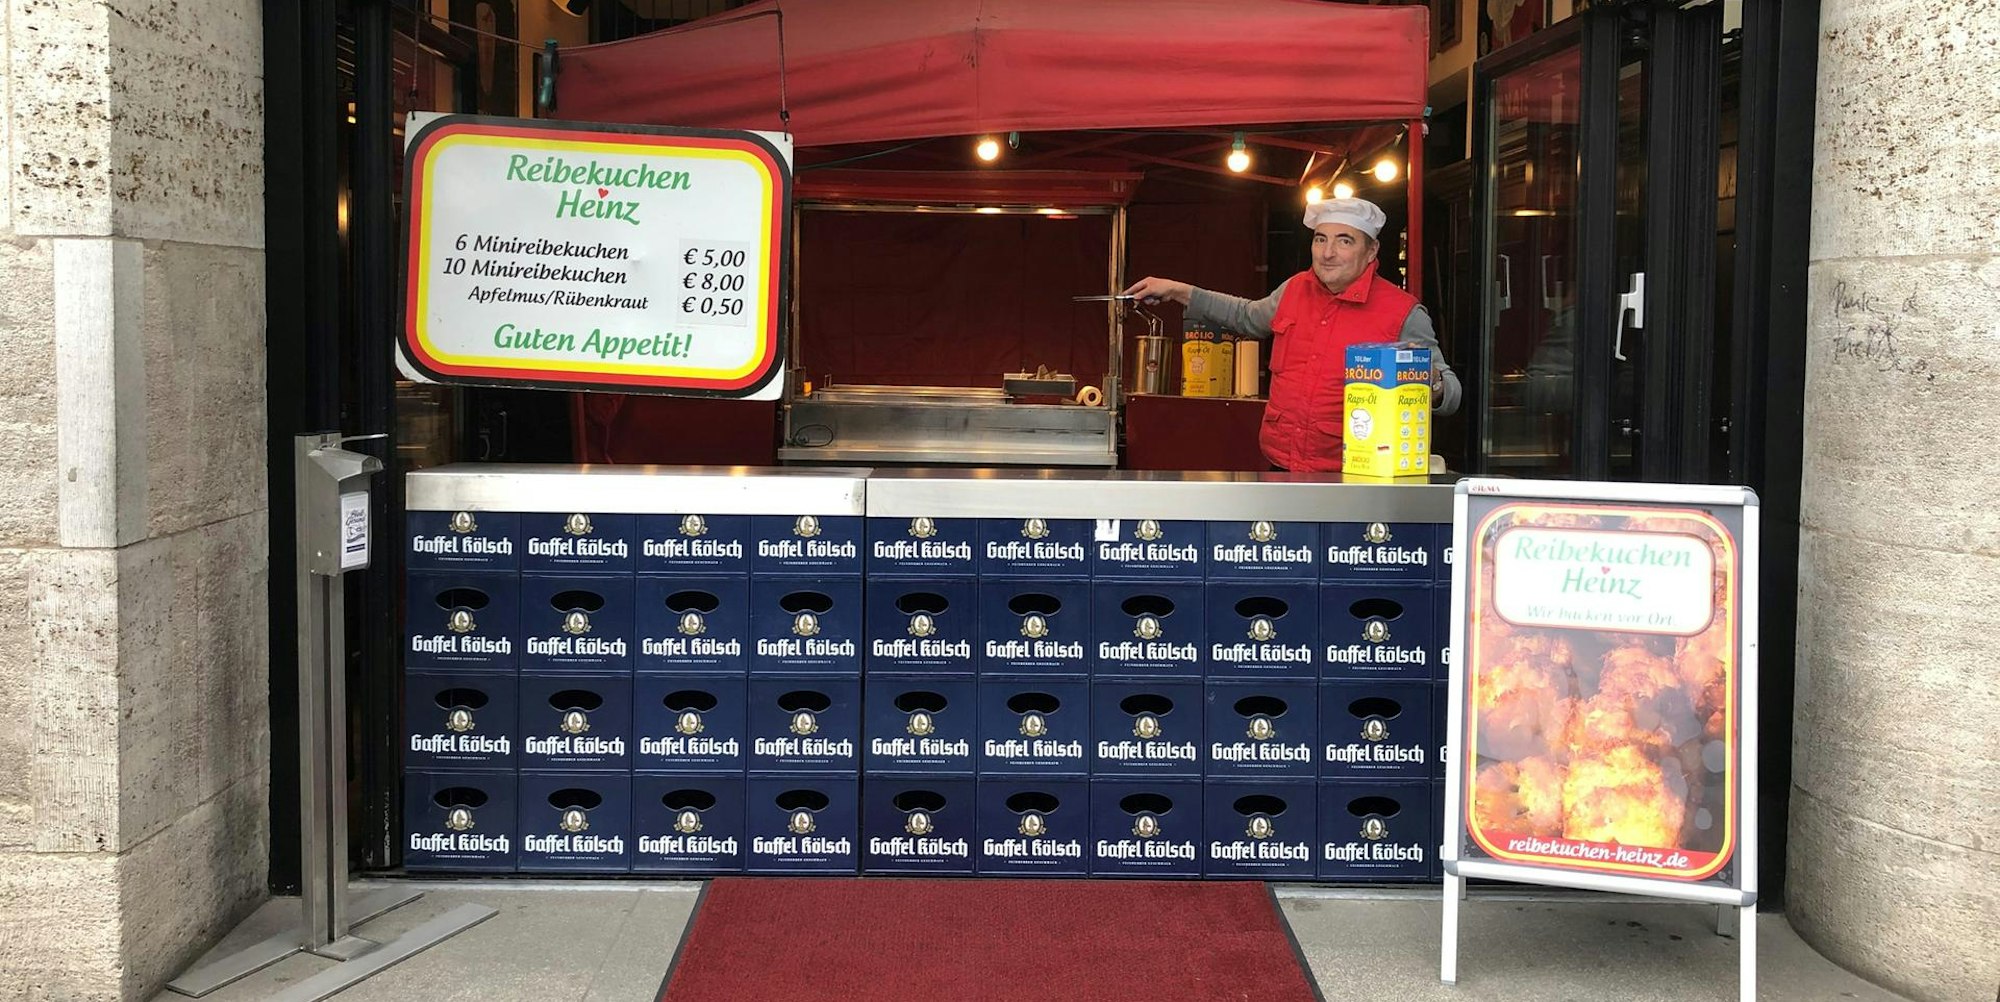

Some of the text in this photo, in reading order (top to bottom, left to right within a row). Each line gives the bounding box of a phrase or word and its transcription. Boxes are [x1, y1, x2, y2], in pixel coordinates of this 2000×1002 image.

[507, 153, 692, 190] Reibekuchen
[555, 188, 641, 225] Heinz
[455, 234, 745, 268] 6 Minireibekuchen € 5,00
[443, 257, 745, 293] 10 Minireibekuchen € 8,00
[468, 286, 744, 317] Apfelmus/Rübenkraut € 0,50
[494, 323, 692, 360] Guten Appetit!
[1398, 393, 1428, 406] Raps-Öl
[414, 535, 512, 555] Gaffel Kölsch
[529, 538, 627, 558] Gaffel Kölsch
[644, 539, 742, 559] Gaffel Kölsch
[759, 540, 856, 558] Gaffel Kölsch
[874, 541, 971, 560] Gaffel Kölsch
[987, 541, 1084, 561] Gaffel Kölsch
[1100, 543, 1197, 563] Gaffel Kölsch
[1214, 544, 1312, 563] Gaffel Kölsch
[1514, 535, 1691, 568] Reibekuchen
[1328, 546, 1374, 565] Gaffel
[1376, 547, 1427, 566] Kölsch
[1561, 566, 1643, 600] Heinz
[1526, 604, 1554, 618] Wir
[1618, 613, 1642, 624] vor
[413, 635, 511, 654] Gaffel Kölsch
[528, 637, 626, 657] Gaffel Kölsch
[643, 638, 740, 656] Gaffel Kölsch
[758, 639, 854, 657] Gaffel Kölsch
[873, 639, 970, 659] Gaffel Kölsch
[986, 640, 1083, 659] Gaffel Kölsch
[1100, 642, 1197, 662] Gaffel Kölsch
[1213, 644, 1311, 664] Gaffel Kölsch
[1327, 645, 1372, 664] Gaffel
[1375, 646, 1425, 665] Kölsch
[411, 734, 510, 755] Gaffel Kölsch
[526, 736, 624, 756] Gaffel Kölsch
[640, 737, 738, 757] Gaffel Kölsch
[755, 738, 852, 758] Gaffel Kölsch
[872, 738, 968, 757] Gaffel Kölsch
[985, 740, 1082, 758] Gaffel Kölsch
[1099, 741, 1196, 761] Gaffel Kölsch
[1212, 743, 1310, 762] Gaffel Kölsch
[1326, 744, 1424, 764] Gaffel Kölsch
[411, 833, 509, 854] Gaffel Kölsch
[525, 835, 623, 854] Gaffel Kölsch
[639, 836, 737, 856] Gaffel Kölsch
[753, 837, 850, 855] Gaffel Kölsch
[870, 837, 968, 857] Gaffel Kölsch
[984, 839, 1081, 858] Gaffel Kölsch
[1097, 840, 1195, 860] Gaffel Kölsch
[1211, 841, 1309, 861] Gaffel Kölsch
[1325, 843, 1423, 863] Gaffel Kölsch
[1508, 836, 1689, 869] reibekuchen-heinz.de
